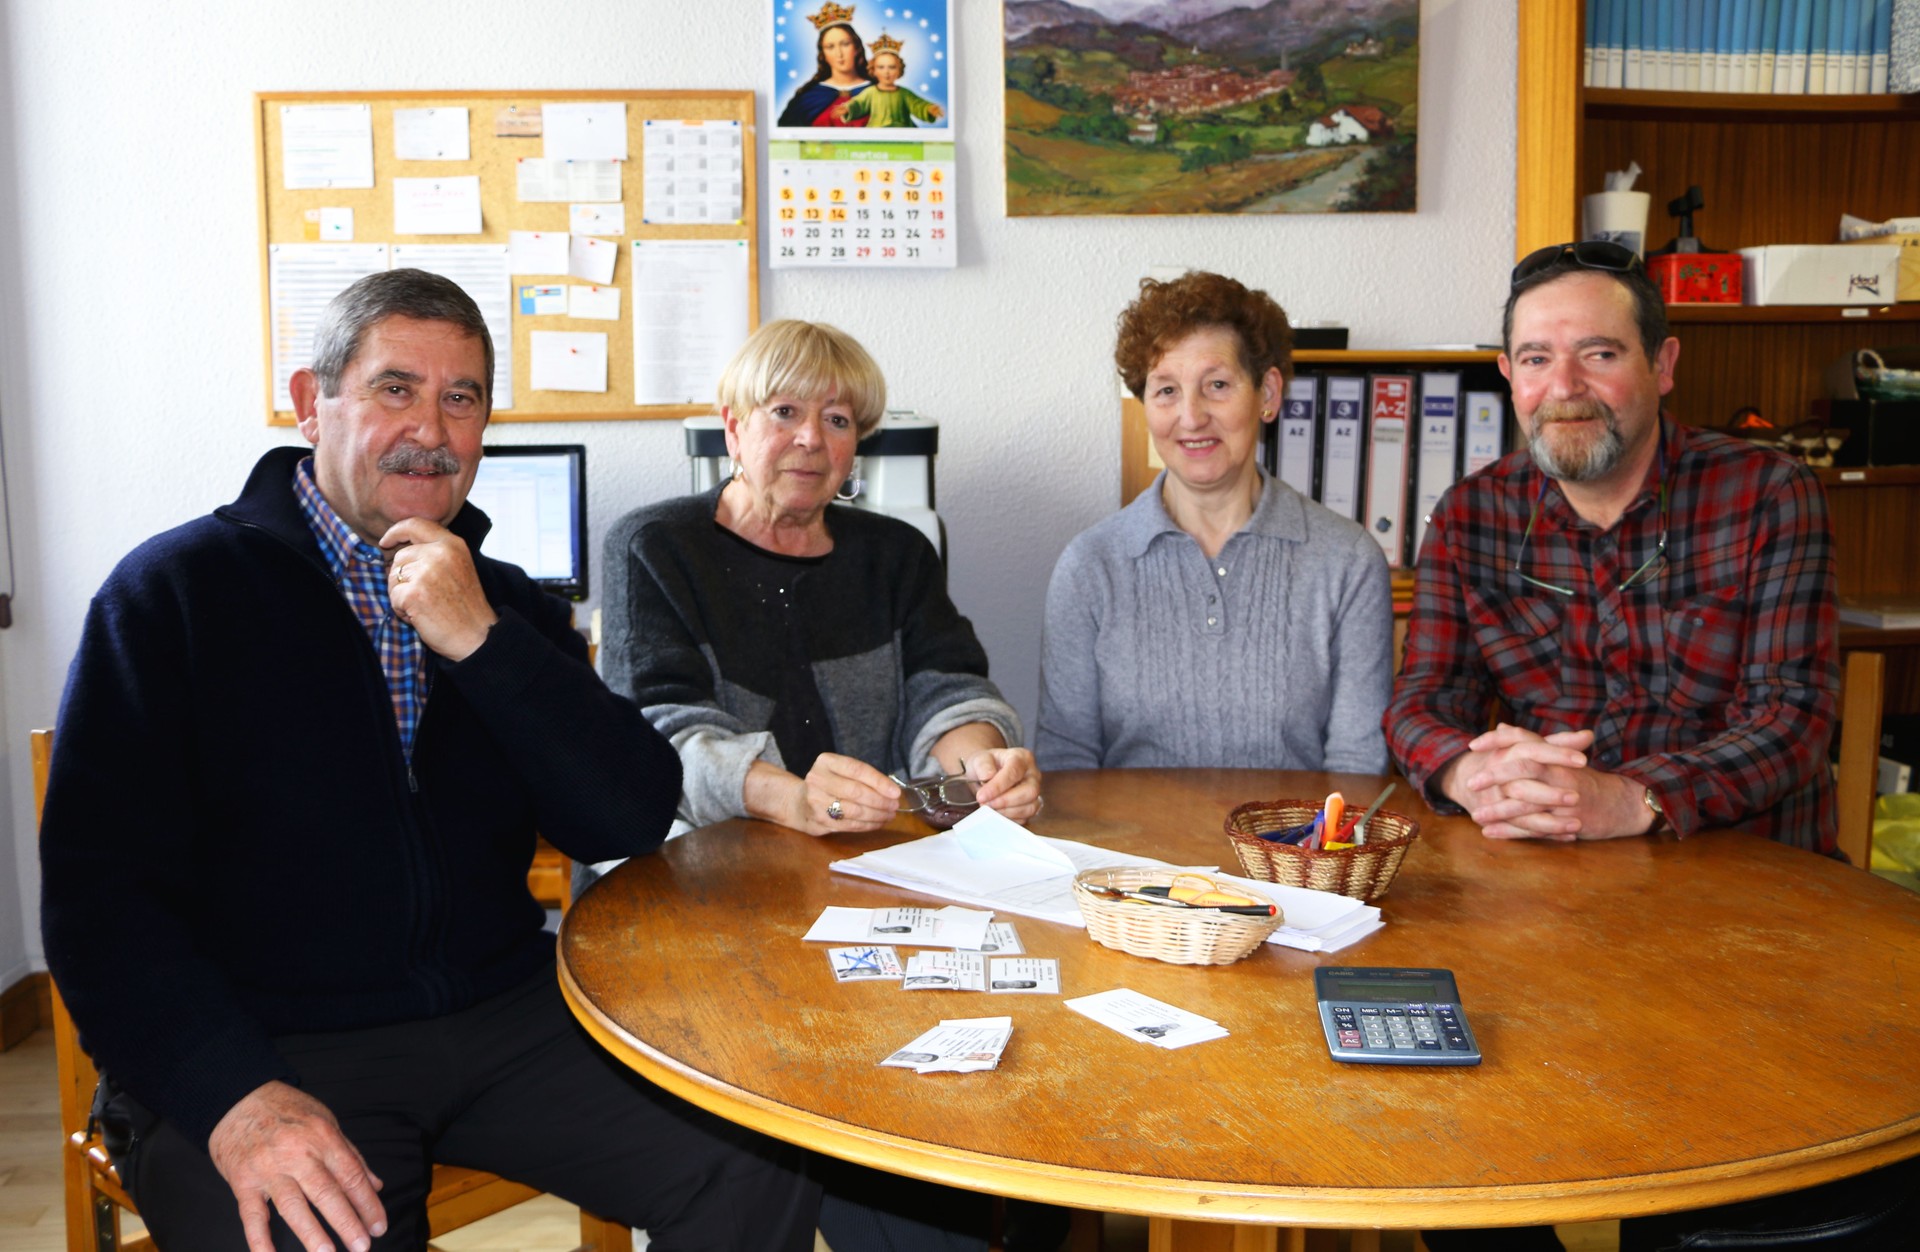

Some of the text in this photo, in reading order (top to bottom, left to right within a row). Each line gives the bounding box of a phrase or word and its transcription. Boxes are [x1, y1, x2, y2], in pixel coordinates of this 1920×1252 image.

[883, 172, 890, 181] 2
[908, 172, 915, 182] 3
[933, 172, 940, 182] 4
[783, 190, 943, 201] 5 6 7 8 9 10 11
[781, 209, 943, 220] 12 13 14 15 16 17 18
[782, 229, 944, 239] 19 20 21 22 23 24 25
[781, 247, 919, 257] 26 27 28 29 30 31
[1375, 401, 1405, 415] A-Z
